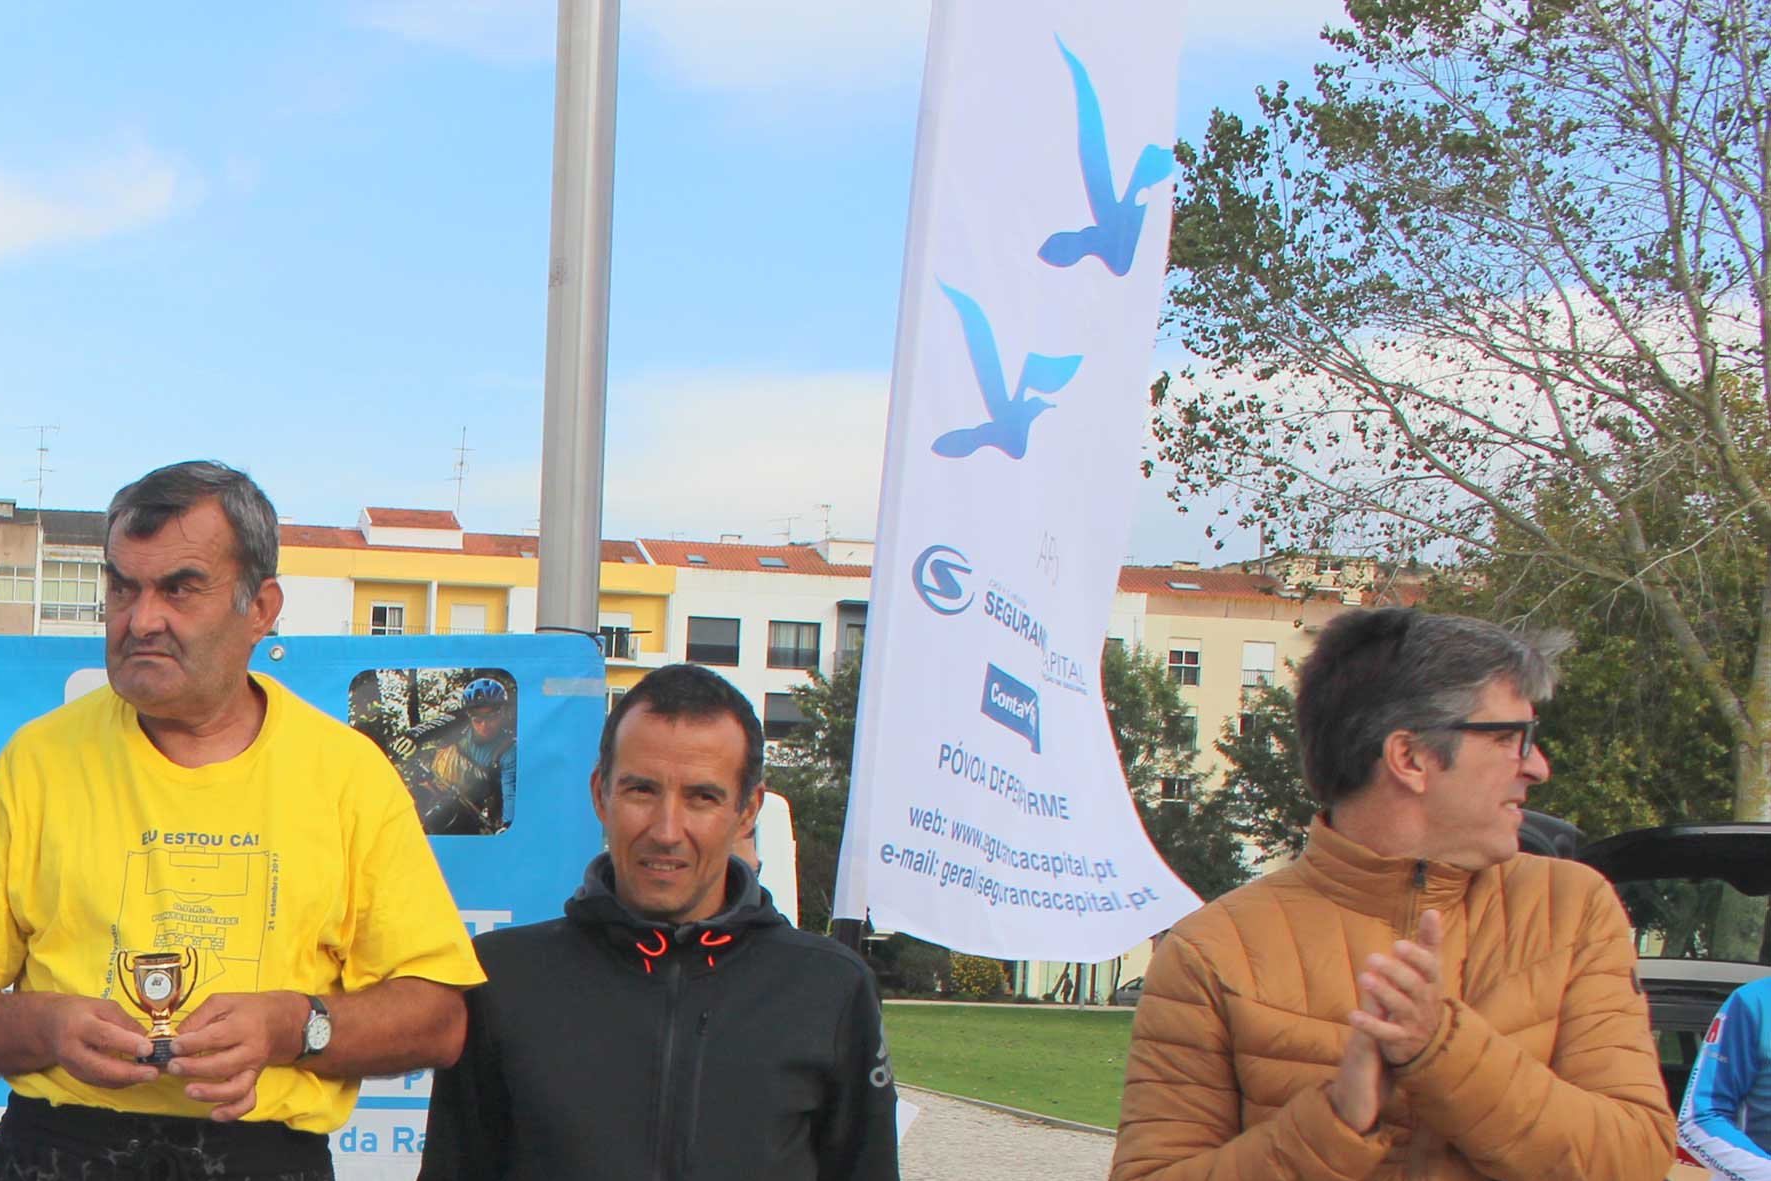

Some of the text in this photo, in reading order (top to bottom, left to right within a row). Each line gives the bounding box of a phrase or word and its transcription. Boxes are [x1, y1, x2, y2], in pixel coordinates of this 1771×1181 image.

[909, 804, 947, 836] web:
[141, 829, 259, 846] EU ESTOU CÁ!
[879, 843, 940, 878] e-mail:
